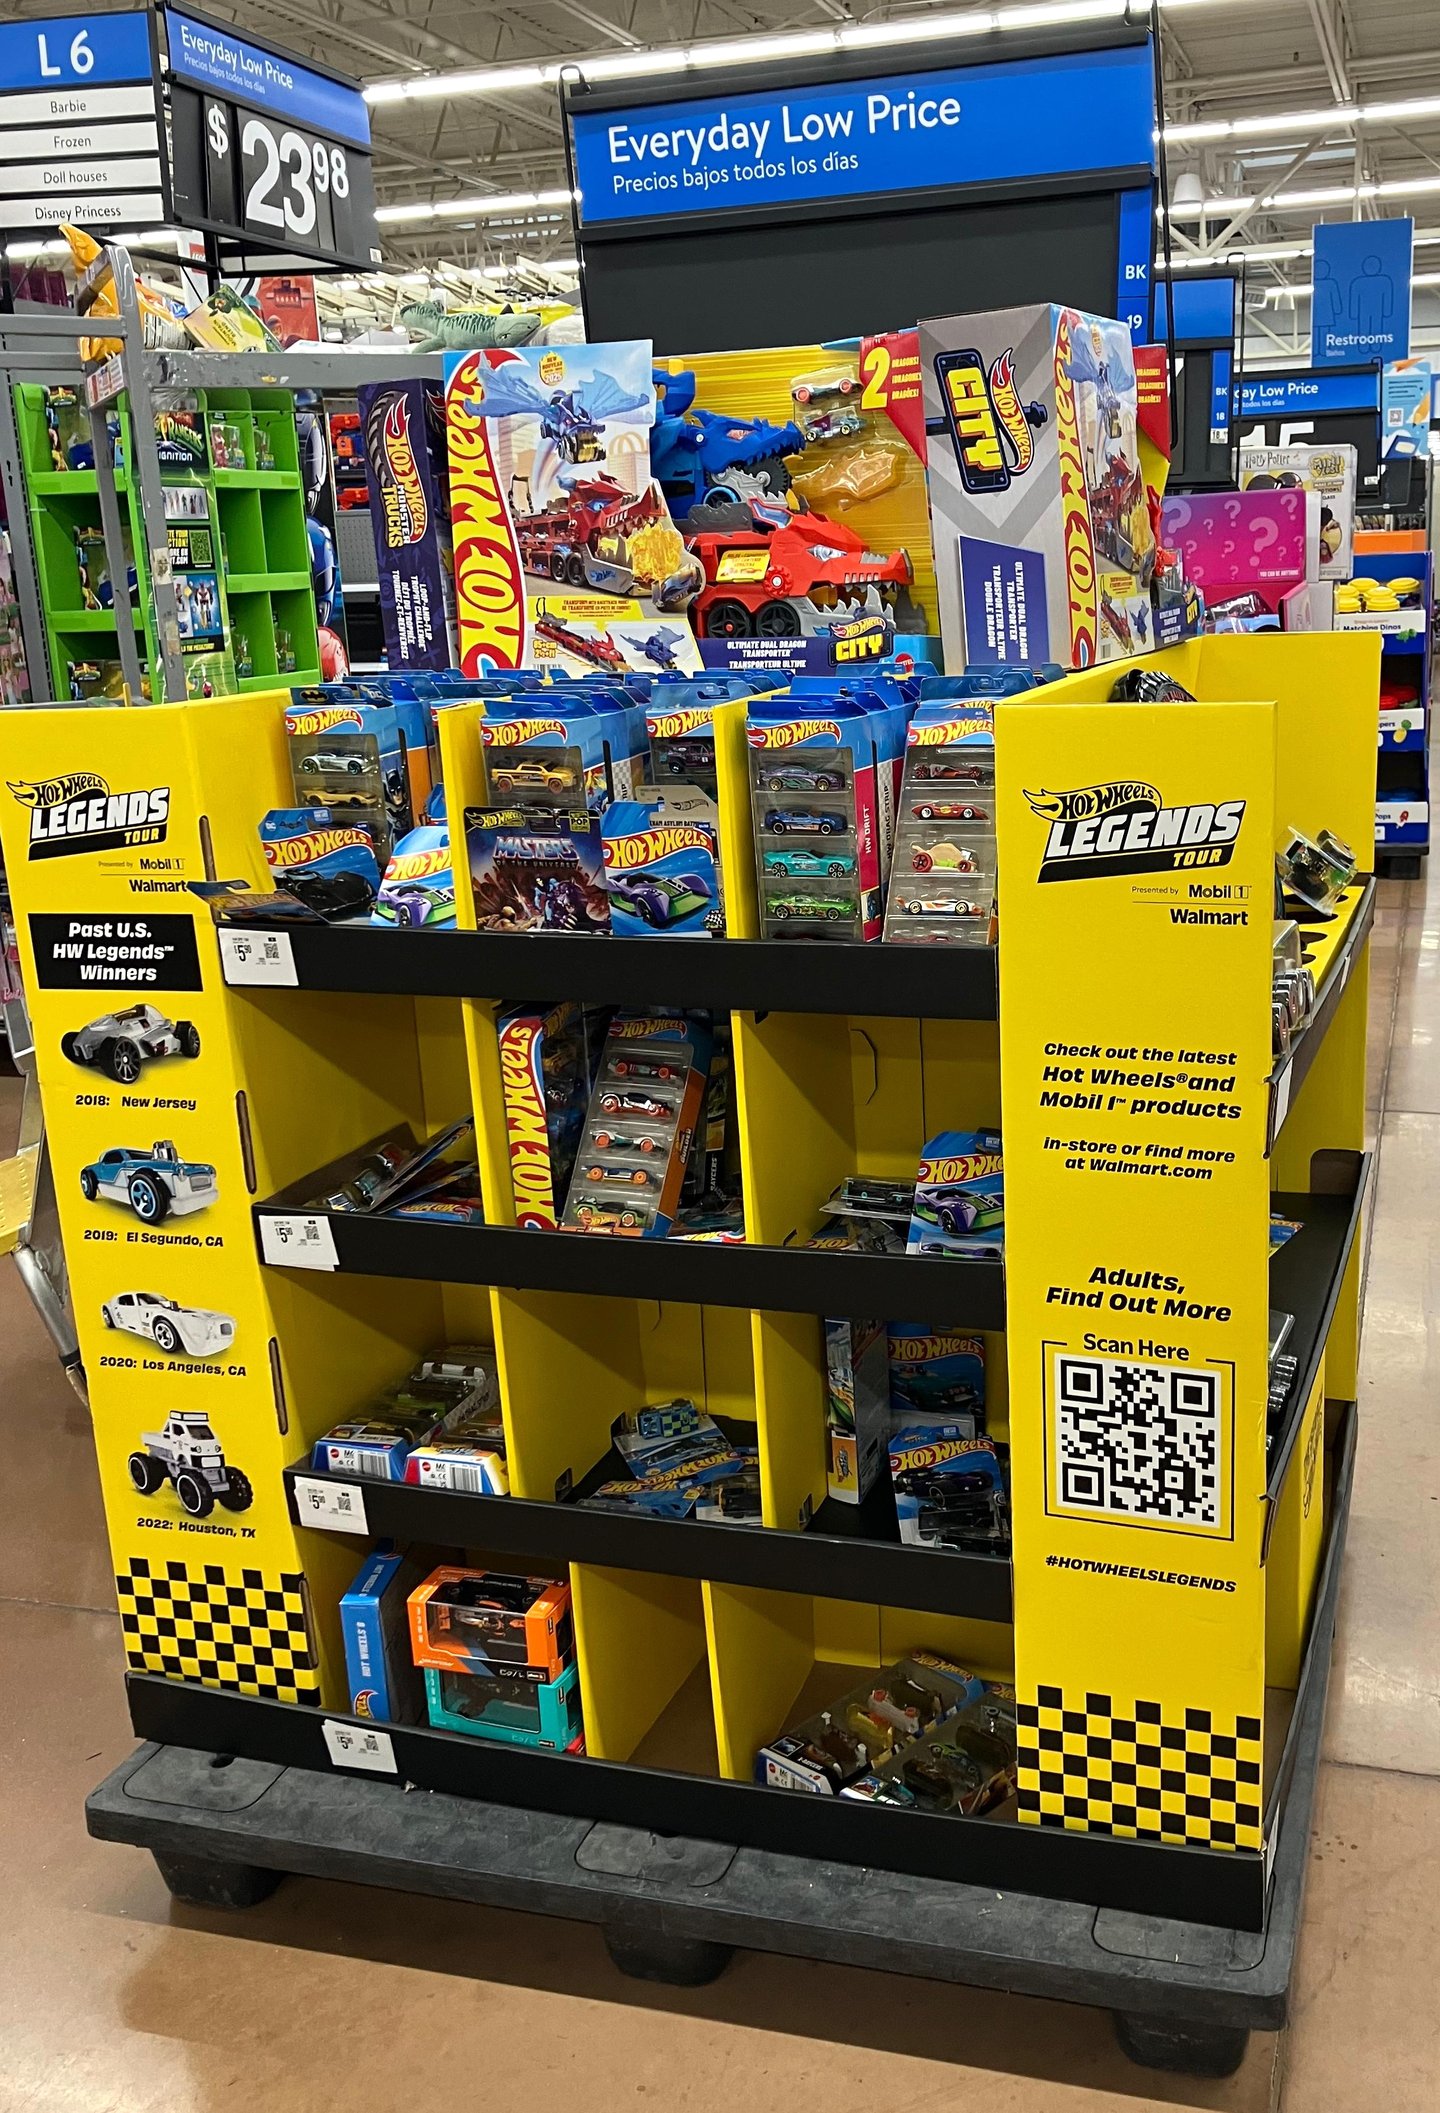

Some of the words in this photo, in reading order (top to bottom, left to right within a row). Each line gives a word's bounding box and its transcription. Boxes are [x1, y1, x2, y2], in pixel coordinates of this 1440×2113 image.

[37, 34, 60, 77] L
[70, 29, 94, 76] 6
[181, 25, 237, 72] Everyday
[240, 49, 264, 76] Low
[265, 60, 293, 90] Price
[50, 100, 87, 113] Barbie
[607, 112, 772, 166] Everyday
[782, 105, 854, 144] Low
[867, 91, 961, 134] Price
[53, 135, 92, 149] Frozen
[43, 171, 67, 184] Doll
[69, 170, 108, 184] houses
[612, 171, 678, 195] Precios
[682, 166, 729, 191] bajos
[734, 159, 786, 183] todos
[791, 156, 818, 176] los
[822, 151, 859, 172] días
[35, 206, 72, 222] Disney
[75, 204, 121, 219] Princess
[1125, 265, 1147, 280] BK
[1127, 315, 1143, 330] 19
[1326, 333, 1394, 347] Restrooms
[862, 346, 890, 410] 2
[1216, 387, 1227, 396] BK
[1260, 385, 1284, 397] Low
[1288, 383, 1318, 396] Price
[947, 368, 1004, 472] CITY
[1216, 412, 1225, 420] 18
[158, 451, 193, 461] IGNITION
[1245, 452, 1266, 469] Harry
[382, 486, 405, 549] TRUCKS
[397, 484, 411, 545] MONSTER
[1015, 561, 1025, 602] ULTIMATE
[984, 581, 994, 613] DOUBLE
[993, 564, 1004, 630] TRANSPORTEUR
[1017, 603, 1027, 626] DUAL
[986, 614, 996, 648] DRAGON
[727, 641, 759, 650] ULTIMATE
[761, 641, 777, 649] DUAL
[779, 640, 807, 648] DRAGON
[836, 633, 883, 662] CITY
[997, 630, 1006, 660] ULTIME
[1019, 626, 1028, 660] DRAGON
[729, 661, 780, 669] TRANSPORTEUR
[781, 660, 806, 669] ULTIME
[31, 788, 169, 840] LEGENDS
[571, 817, 588, 827] POP
[124, 828, 160, 845] TOUR
[884, 813, 892, 841] DRAG
[1046, 801, 1246, 858] LEGENDS
[494, 836, 580, 861] MASTERS
[865, 837, 871, 855] HW
[98, 860, 126, 868] Presented
[140, 859, 171, 870] Mobil
[532, 861, 577, 869] UNIVERSE
[1173, 848, 1223, 867] TOUR
[129, 879, 188, 893] Walmart
[1131, 885, 1169, 895] Presented
[1170, 886, 1179, 896] by
[1189, 885, 1231, 899] Mobil
[1170, 908, 1249, 926] Walmart
[69, 922, 113, 938] Past
[117, 923, 152, 938] U.S.
[53, 943, 84, 960] HW
[80, 964, 158, 981] Winners
[1044, 1042, 1102, 1058] Check
[1105, 1046, 1138, 1061] out
[1142, 1047, 1174, 1062] the
[1177, 1049, 1238, 1066] latest
[1042, 1066, 1085, 1083] Hot
[1188, 1076, 1236, 1093] and
[75, 1095, 110, 1106] 2018:
[122, 1096, 150, 1108] New
[152, 1097, 197, 1110] Jersey
[1040, 1091, 1103, 1111] Mobil
[1130, 1097, 1242, 1119] products
[1043, 1136, 1117, 1154] in-store
[1121, 1141, 1141, 1156] or
[1145, 1143, 1184, 1159] find
[1186, 1148, 1236, 1163] more
[1065, 1156, 1085, 1170] at
[1090, 1159, 1213, 1180] Walmart.com
[84, 1229, 118, 1241] 2019:
[127, 1231, 139, 1243] El
[141, 1232, 203, 1248] Segundo,
[205, 1236, 224, 1248] CA
[1089, 1266, 1186, 1295] Adults,
[1046, 1287, 1102, 1309] Find
[1108, 1292, 1158, 1315] Out
[1163, 1298, 1232, 1322] More
[1083, 1333, 1133, 1355] Scan
[1138, 1339, 1190, 1361] Here
[100, 1356, 137, 1369] 2020:
[143, 1358, 164, 1371] Los
[167, 1360, 225, 1377] Angeles,
[228, 1365, 247, 1377] CA
[137, 1517, 173, 1531] 2022:
[178, 1521, 237, 1538] Houston,
[241, 1527, 256, 1539] TX
[1045, 1554, 1237, 1593] #HOTWHEELSLEGENDS
[358, 1628, 369, 1661] WHEELS
[361, 1661, 372, 1678] HOT
